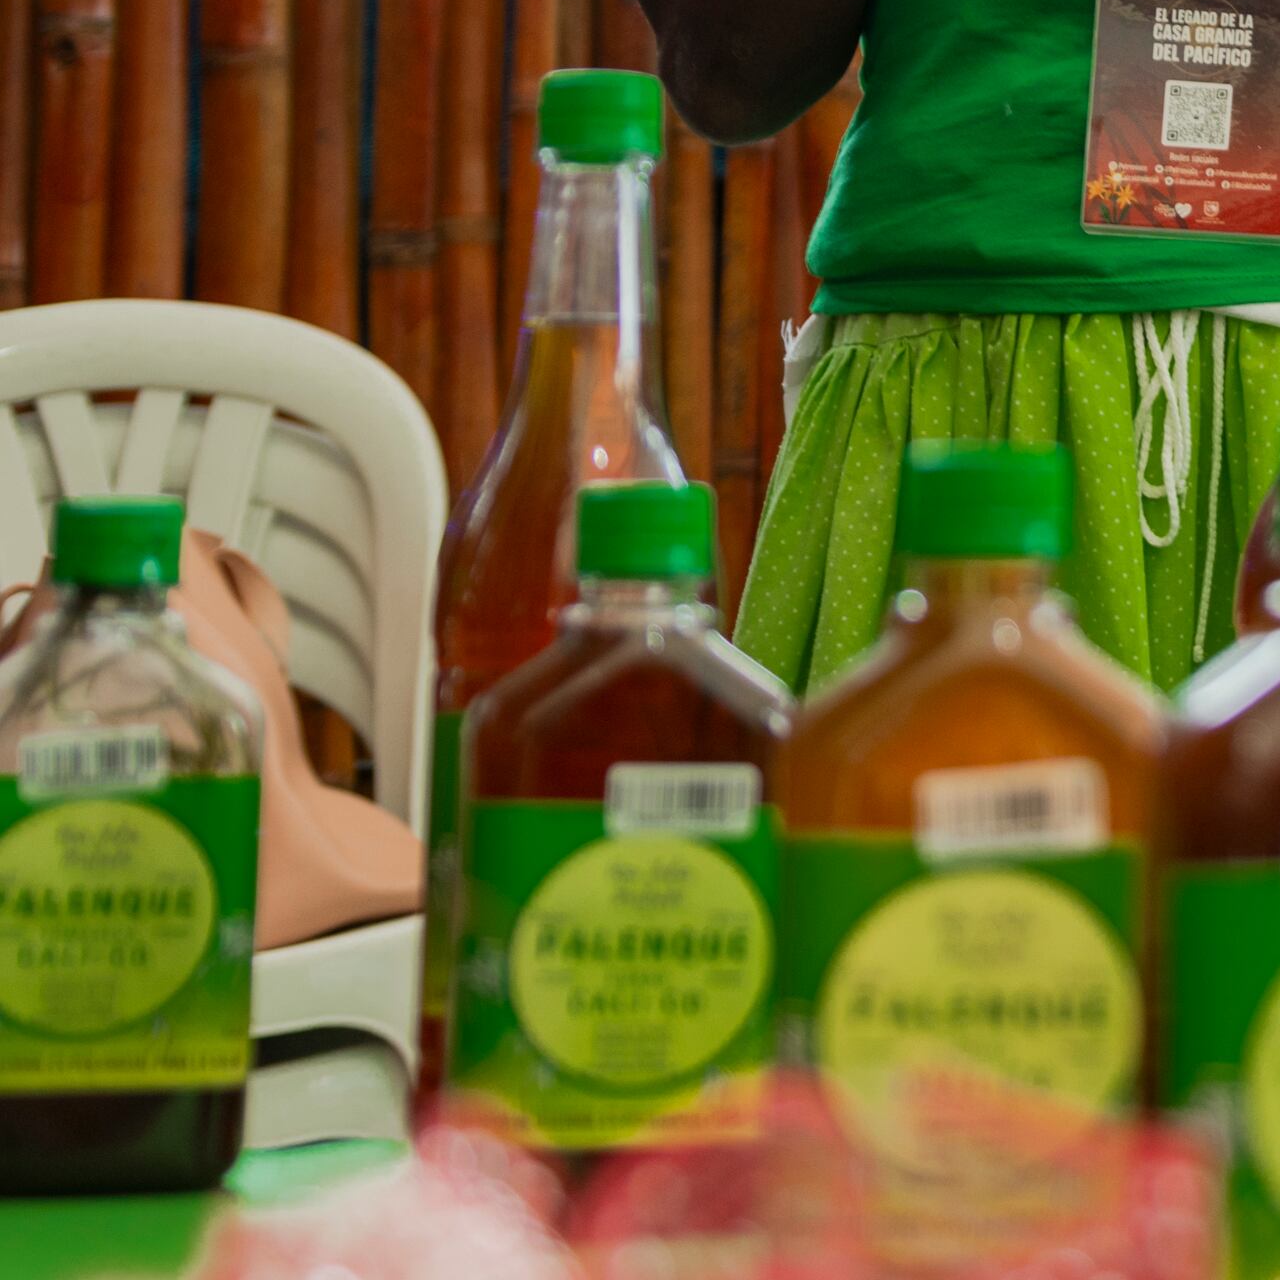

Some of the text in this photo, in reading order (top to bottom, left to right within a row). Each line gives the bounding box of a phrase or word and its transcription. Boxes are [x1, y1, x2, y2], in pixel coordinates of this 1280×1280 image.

[1155, 7, 1254, 29] EL LEGADO DE LA
[1152, 22, 1254, 47] CASA GRANDE
[1152, 42, 1253, 68] DEL PACÍFICO
